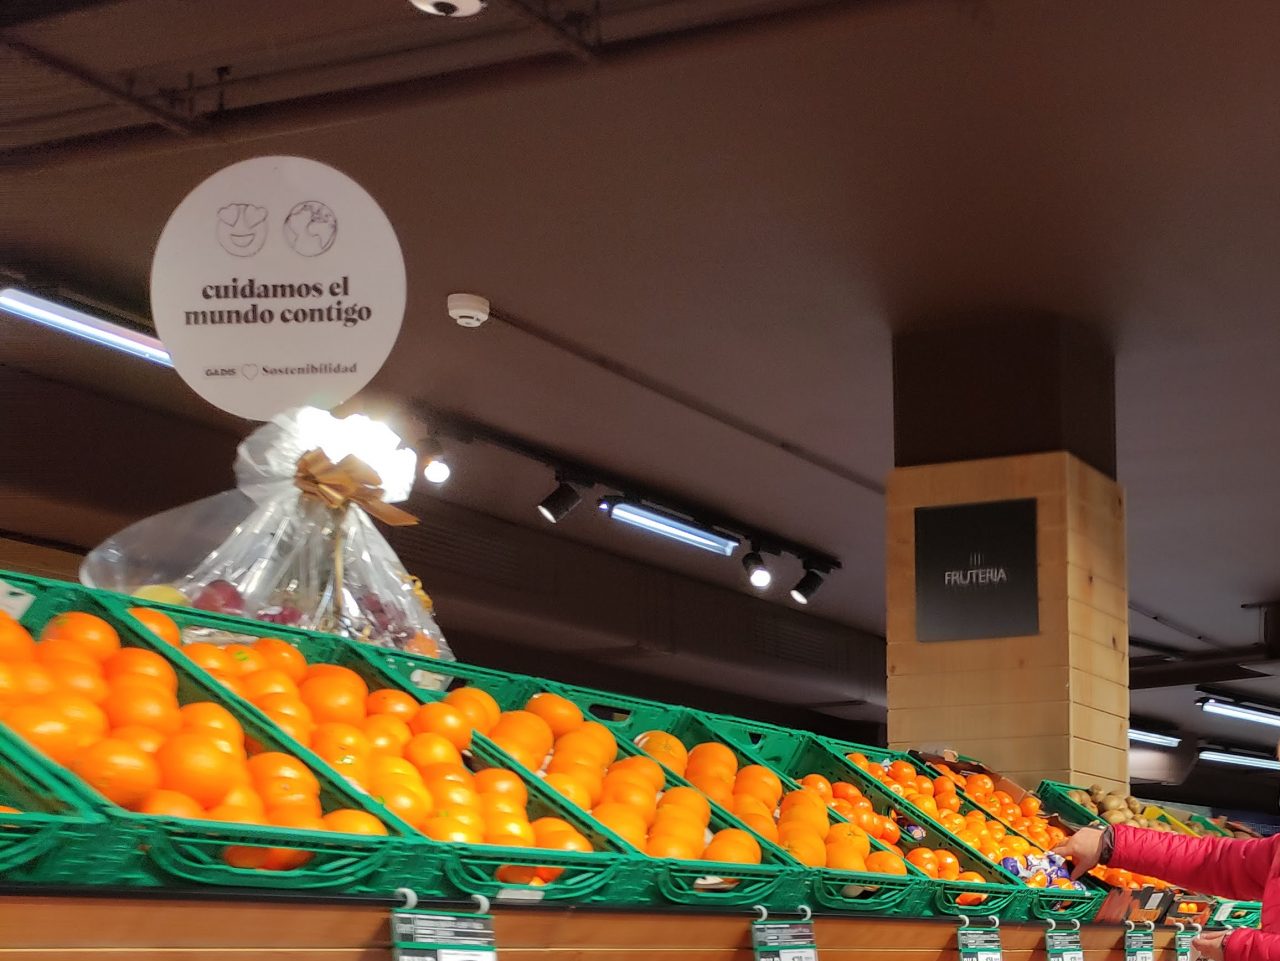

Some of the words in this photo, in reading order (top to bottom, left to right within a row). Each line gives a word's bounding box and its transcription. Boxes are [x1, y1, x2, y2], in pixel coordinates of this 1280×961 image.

[202, 278, 322, 300] cuidamos
[329, 276, 350, 296] el
[184, 304, 275, 325] mundo
[280, 301, 372, 328] contigo
[262, 363, 358, 377] Sostenibilidad
